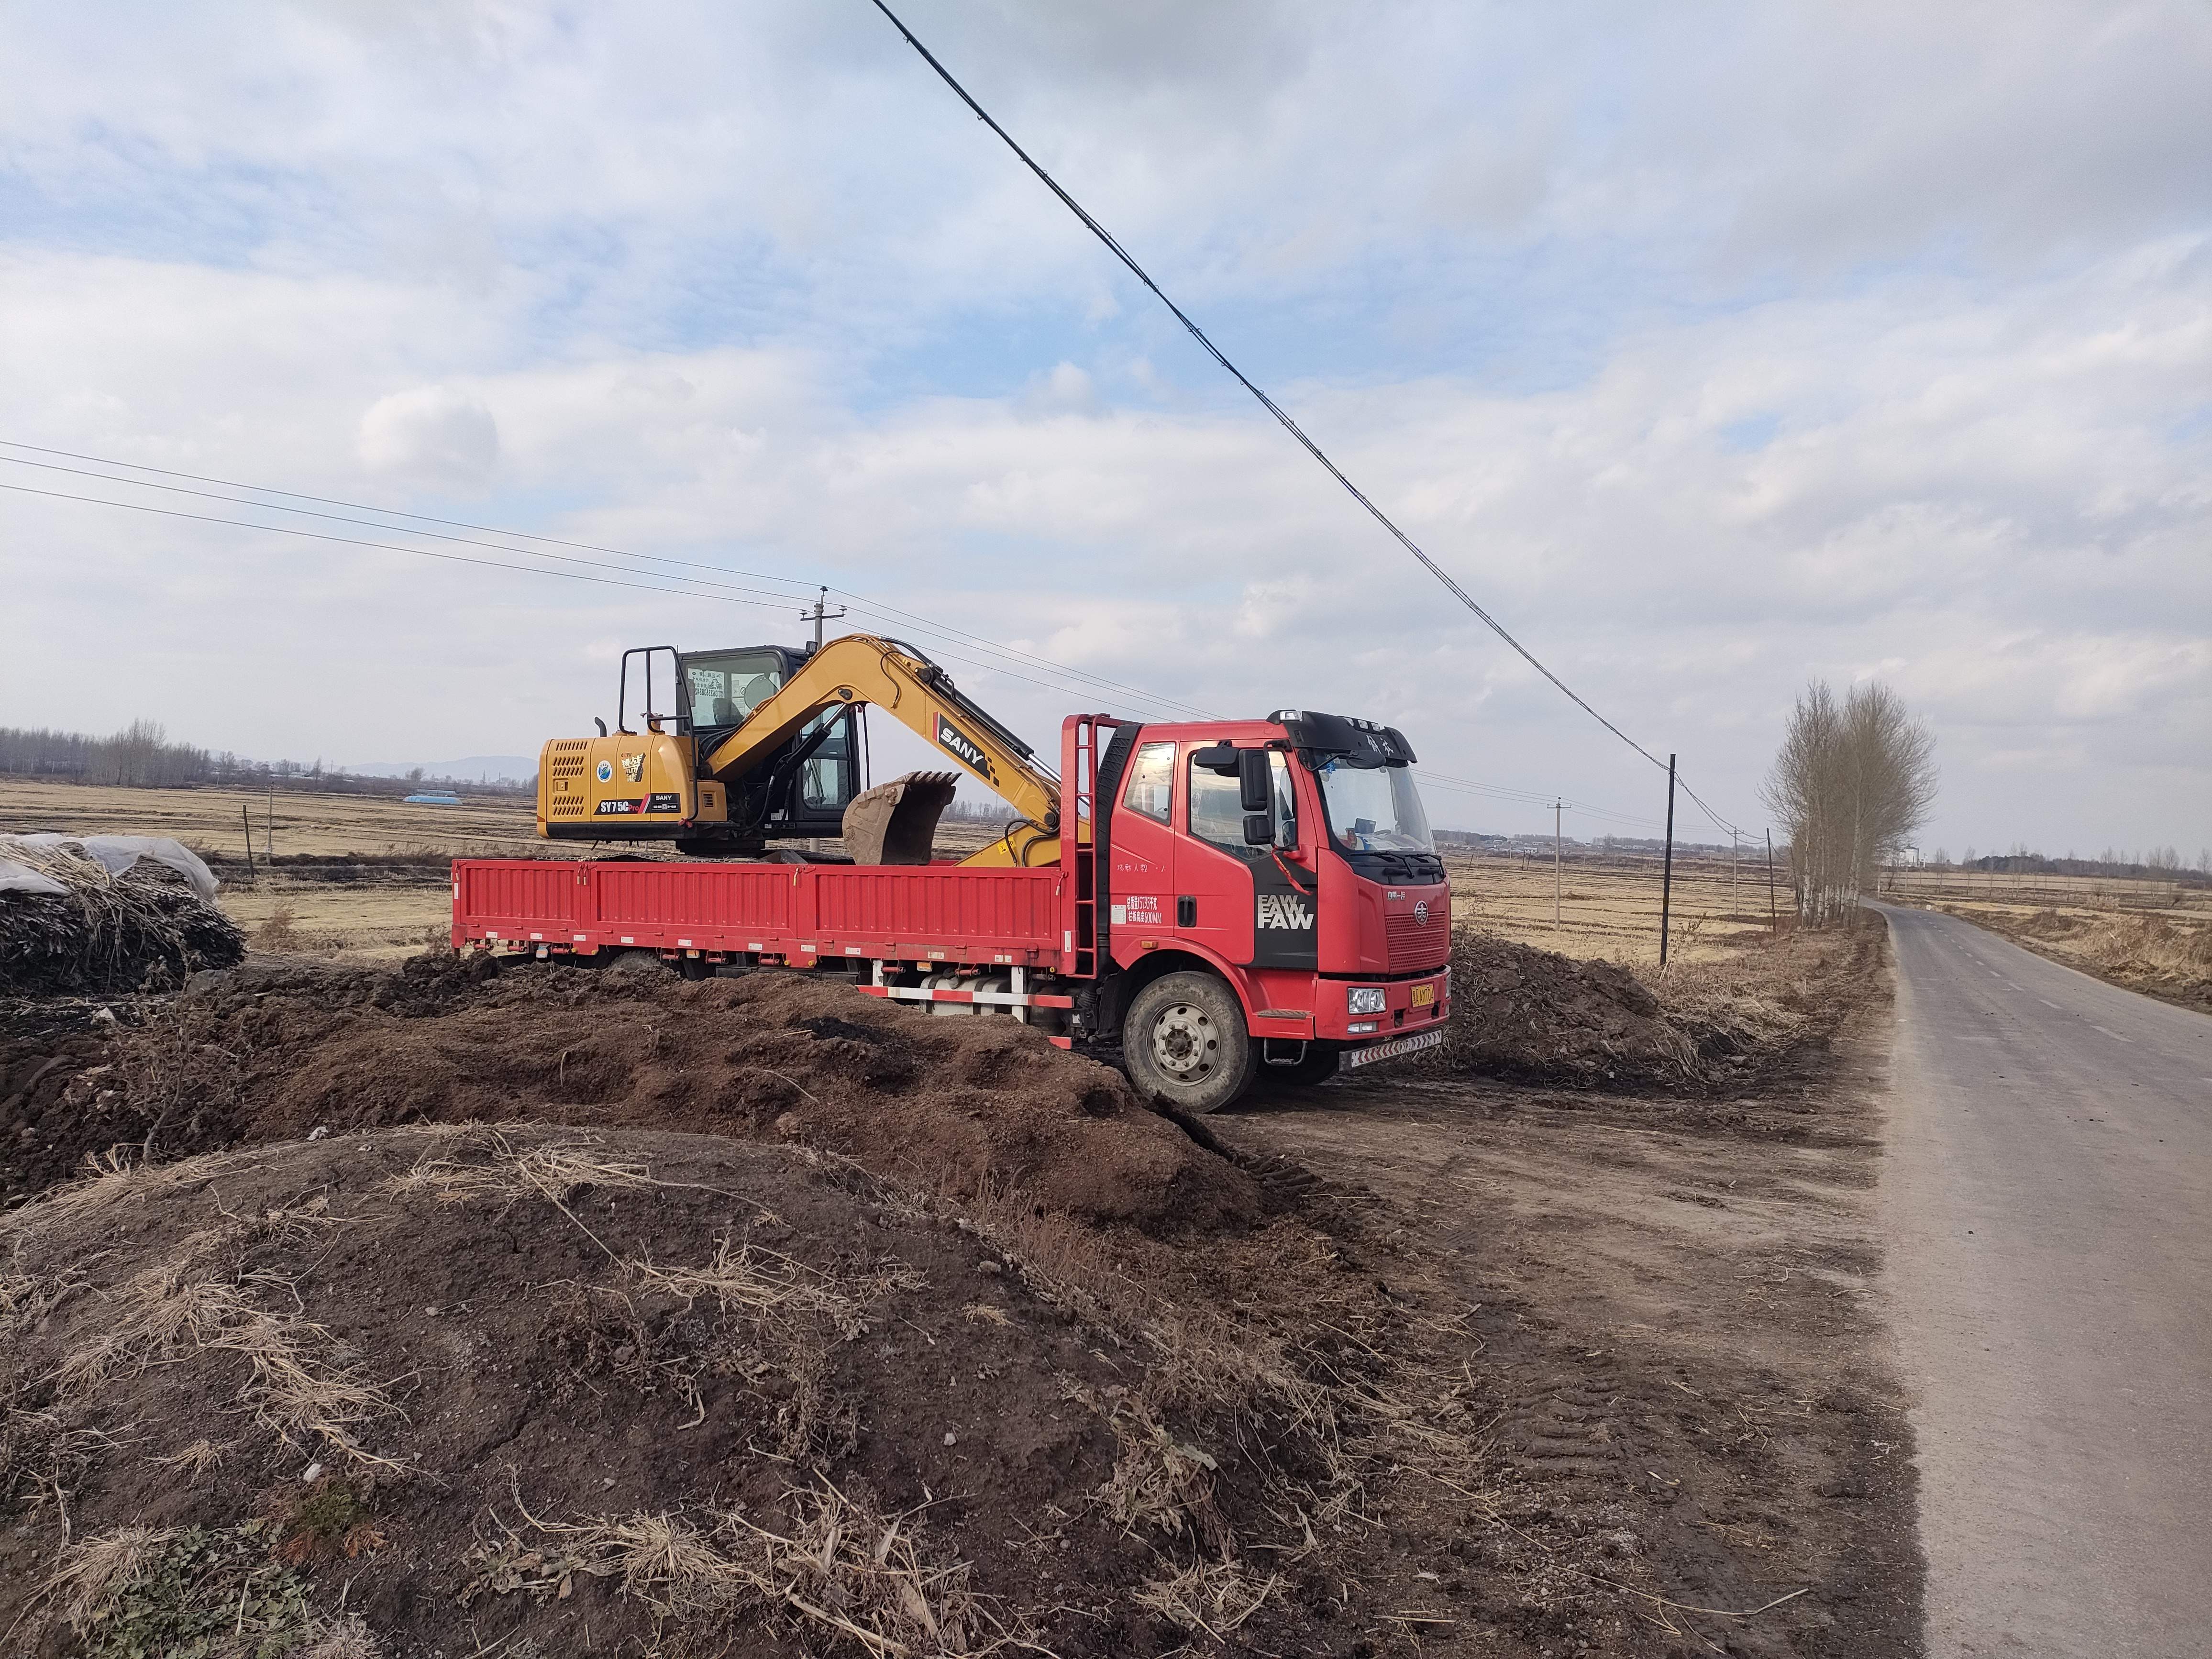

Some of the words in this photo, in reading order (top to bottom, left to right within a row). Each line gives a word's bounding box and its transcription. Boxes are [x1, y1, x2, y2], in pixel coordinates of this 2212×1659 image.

[940, 728, 984, 764] SANY
[1258, 895, 1298, 906] FAW
[1258, 903, 1305, 917] FAW
[1258, 913, 1314, 930] FAW
